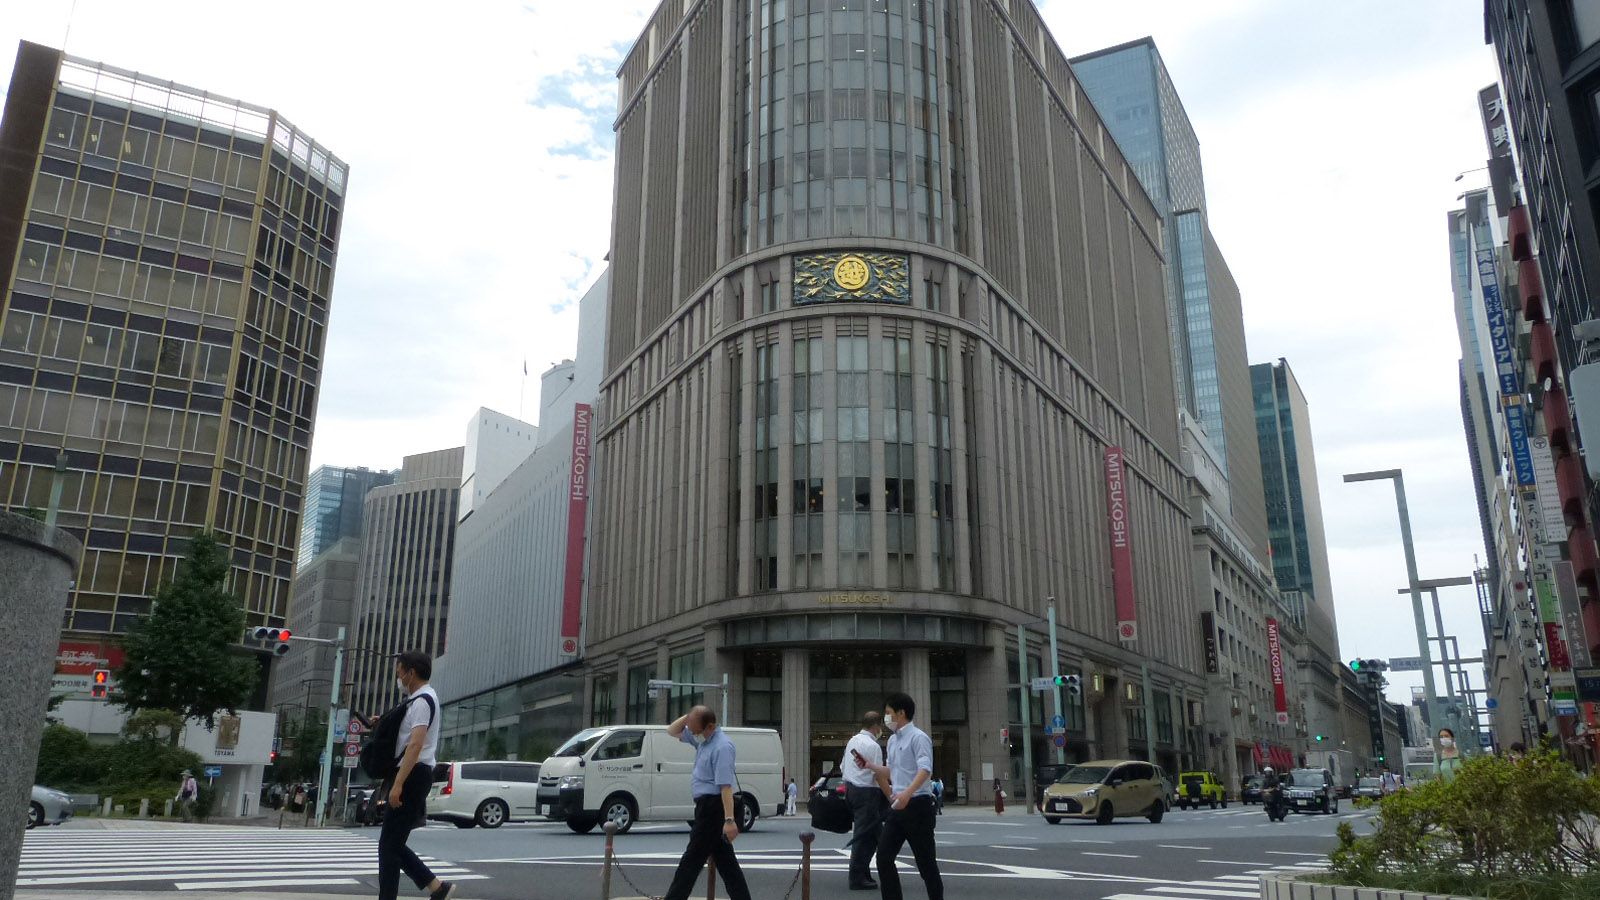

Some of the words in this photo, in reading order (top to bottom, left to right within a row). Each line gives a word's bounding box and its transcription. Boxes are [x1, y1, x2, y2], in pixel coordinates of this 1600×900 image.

[572, 409, 589, 501] MITSUKOSHI
[1107, 453, 1126, 548] MITSUKOSHI
[817, 592, 893, 605] MITSUKOSHI
[1267, 624, 1283, 685] MITSUKOSHI
